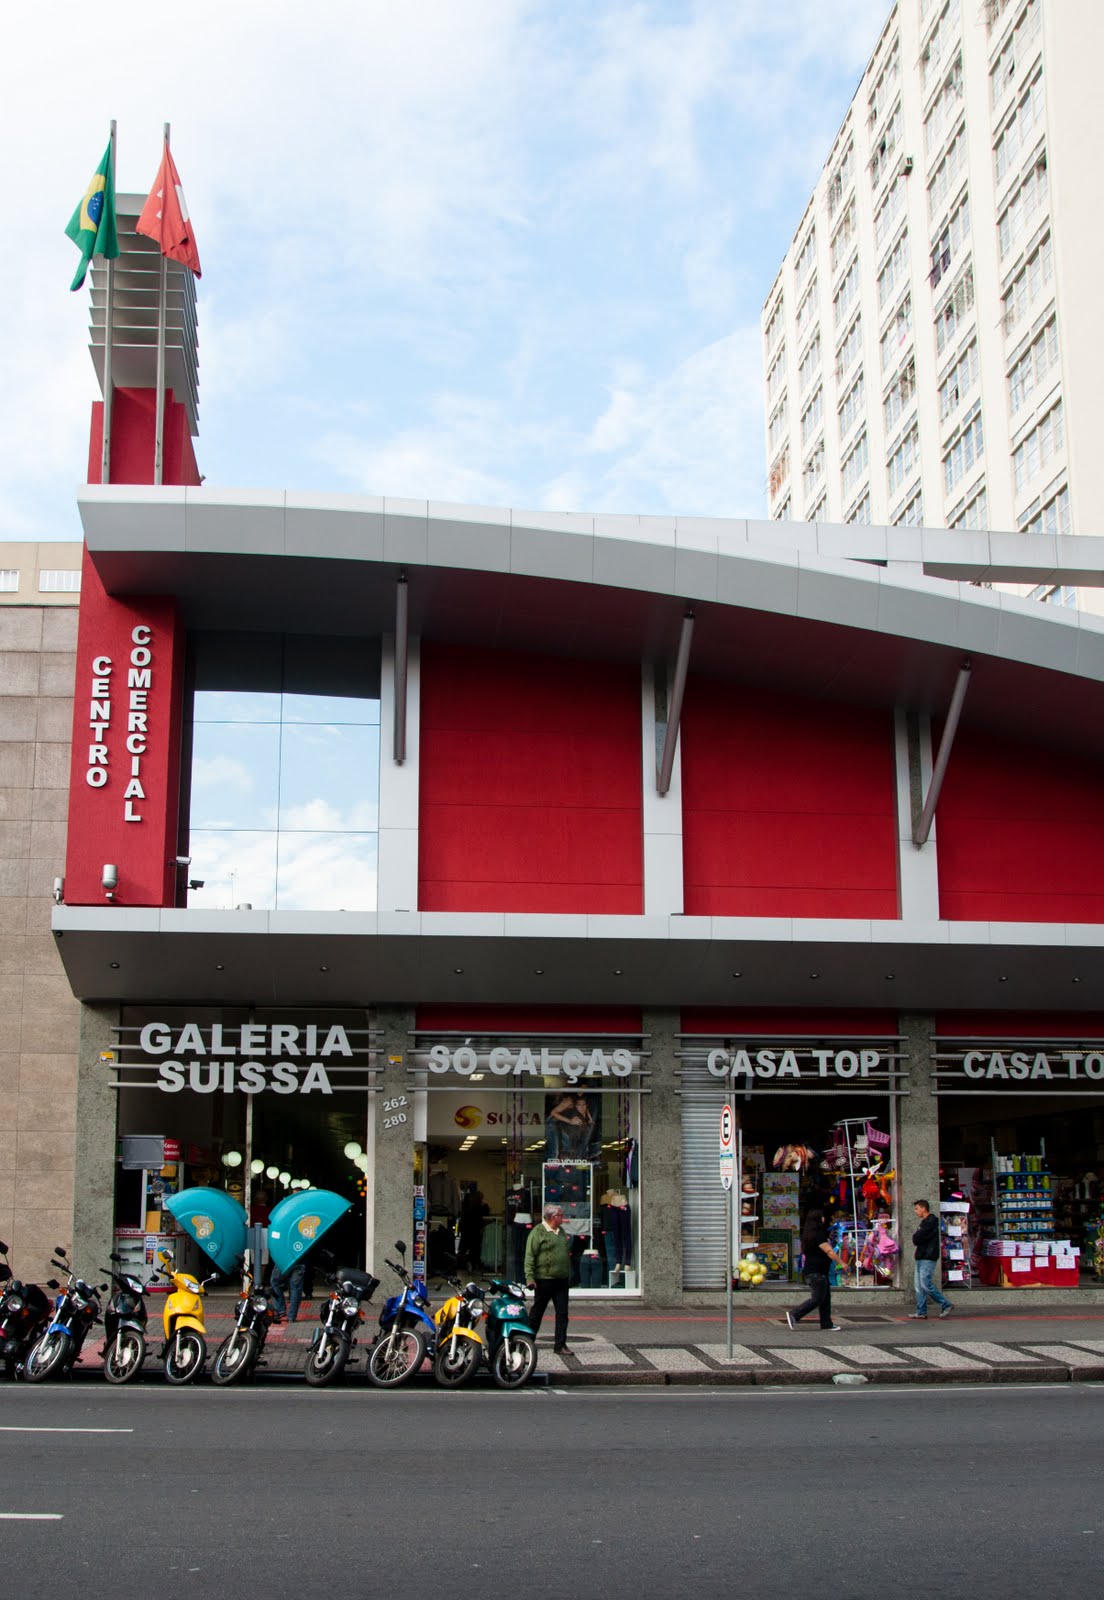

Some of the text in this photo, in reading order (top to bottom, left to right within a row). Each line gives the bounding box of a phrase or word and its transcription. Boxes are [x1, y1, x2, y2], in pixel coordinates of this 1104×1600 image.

[86, 656, 112, 787] CENTRO
[124, 625, 151, 822] COMERCIAL
[140, 1022, 353, 1056] GALERIA
[428, 1038, 633, 1083] SÓ CALÇAS
[707, 1050, 880, 1078] CASA TOP
[963, 1051, 1053, 1079] CASA
[157, 1061, 334, 1094] SUISSA
[383, 1095, 408, 1112] 262
[383, 1112, 407, 1129] 280
